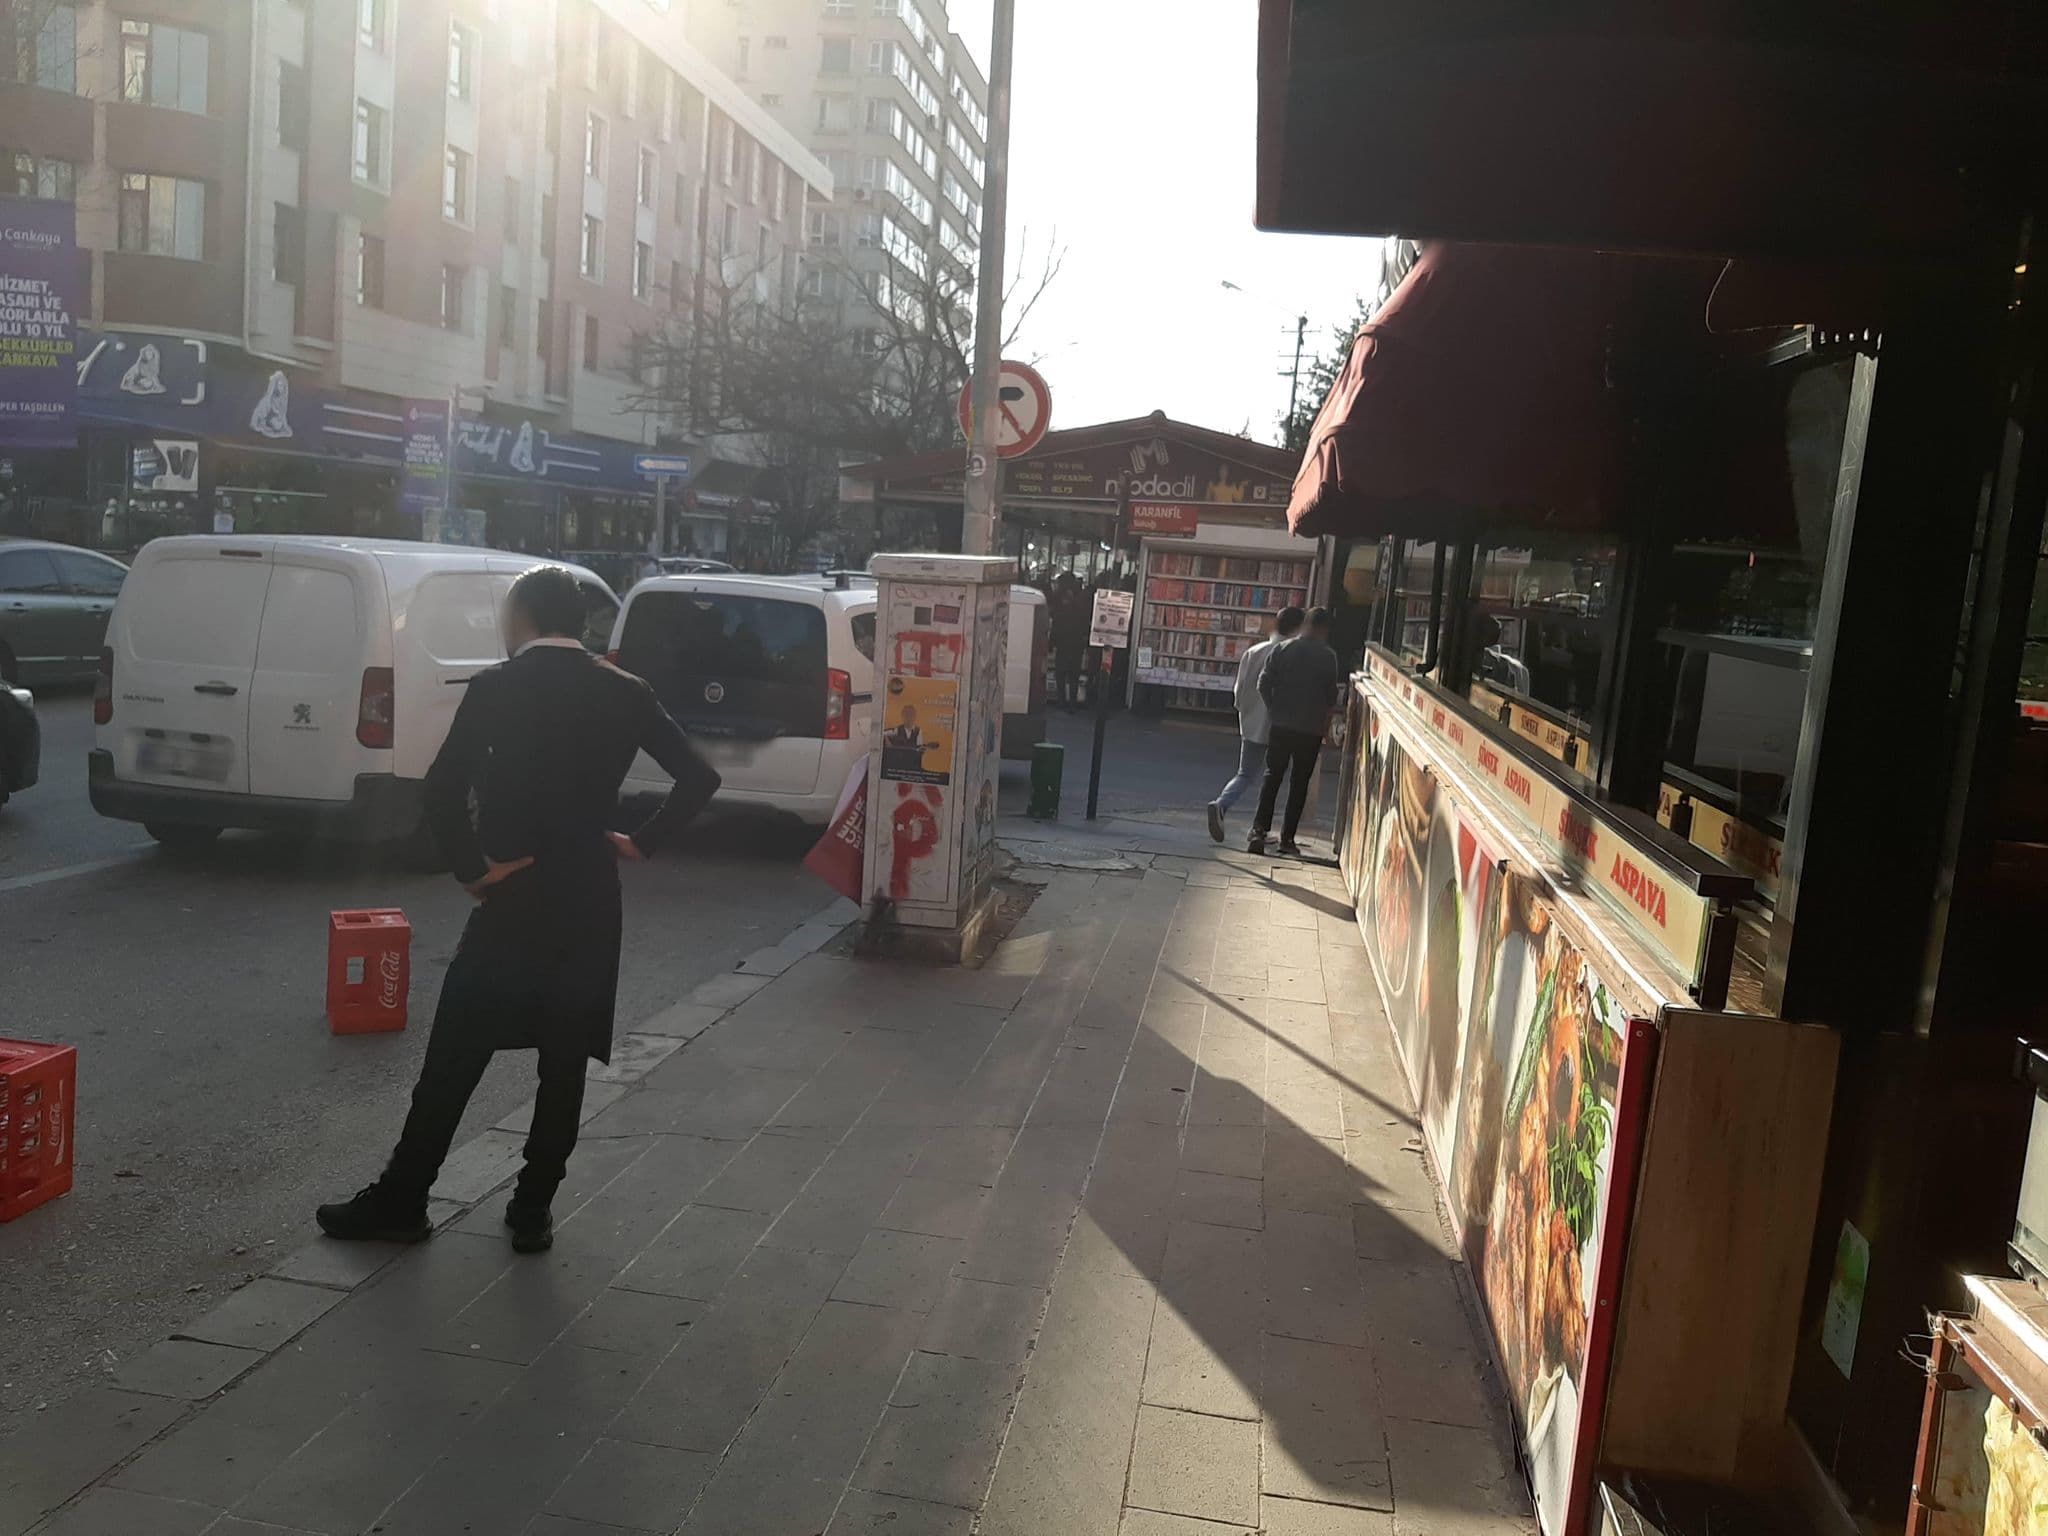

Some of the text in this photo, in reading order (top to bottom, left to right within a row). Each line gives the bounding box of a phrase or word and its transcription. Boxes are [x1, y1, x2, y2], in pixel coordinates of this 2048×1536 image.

[5, 228, 61, 246] Çankaya
[43, 295, 62, 310] VE
[25, 324, 41, 337] 10
[44, 325, 66, 338] YIL
[1134, 505, 1183, 519] KARANFİL
[1545, 727, 1565, 750] ASPAV
[1478, 739, 1531, 806] ŞİMŞEK ASPAVA
[1558, 800, 1666, 929] ŞİMŞEK ASPAVA
